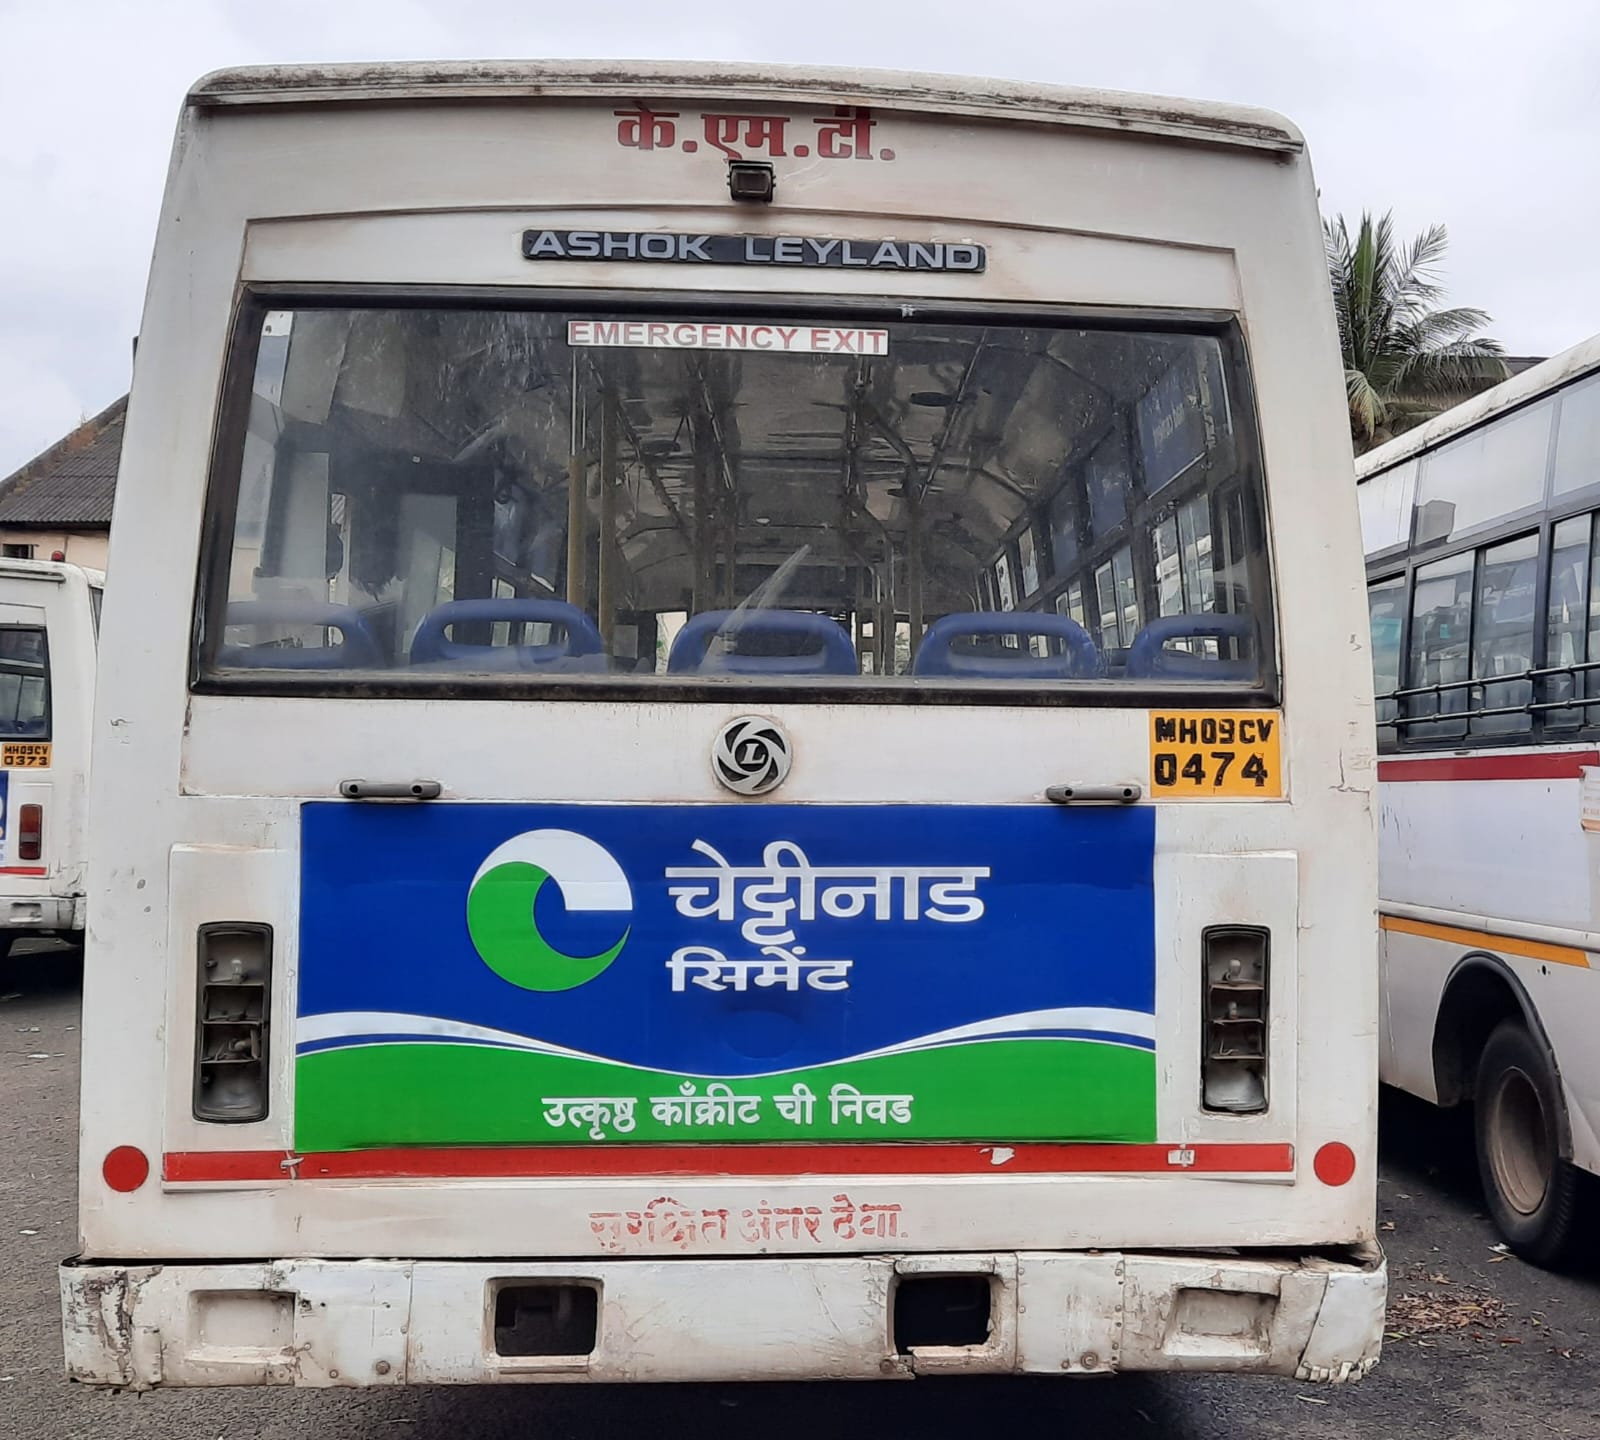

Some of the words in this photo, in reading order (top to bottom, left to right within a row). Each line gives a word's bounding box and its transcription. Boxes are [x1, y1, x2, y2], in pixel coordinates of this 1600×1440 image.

[529, 231, 712, 260] ASHOK
[744, 236, 980, 270] LEYLAND
[570, 322, 798, 349] EMERGENCY
[810, 329, 886, 353] EXIT
[1155, 717, 1274, 744] MH09CV
[4, 745, 48, 755] MH09CV
[4, 755, 47, 766] 0373
[1154, 752, 1268, 786] 0474
[665, 838, 991, 945] चेट्टीनाड
[665, 946, 853, 992] सिमेंट
[773, 1083, 816, 1125] ची
[828, 1083, 914, 1126] निवड
